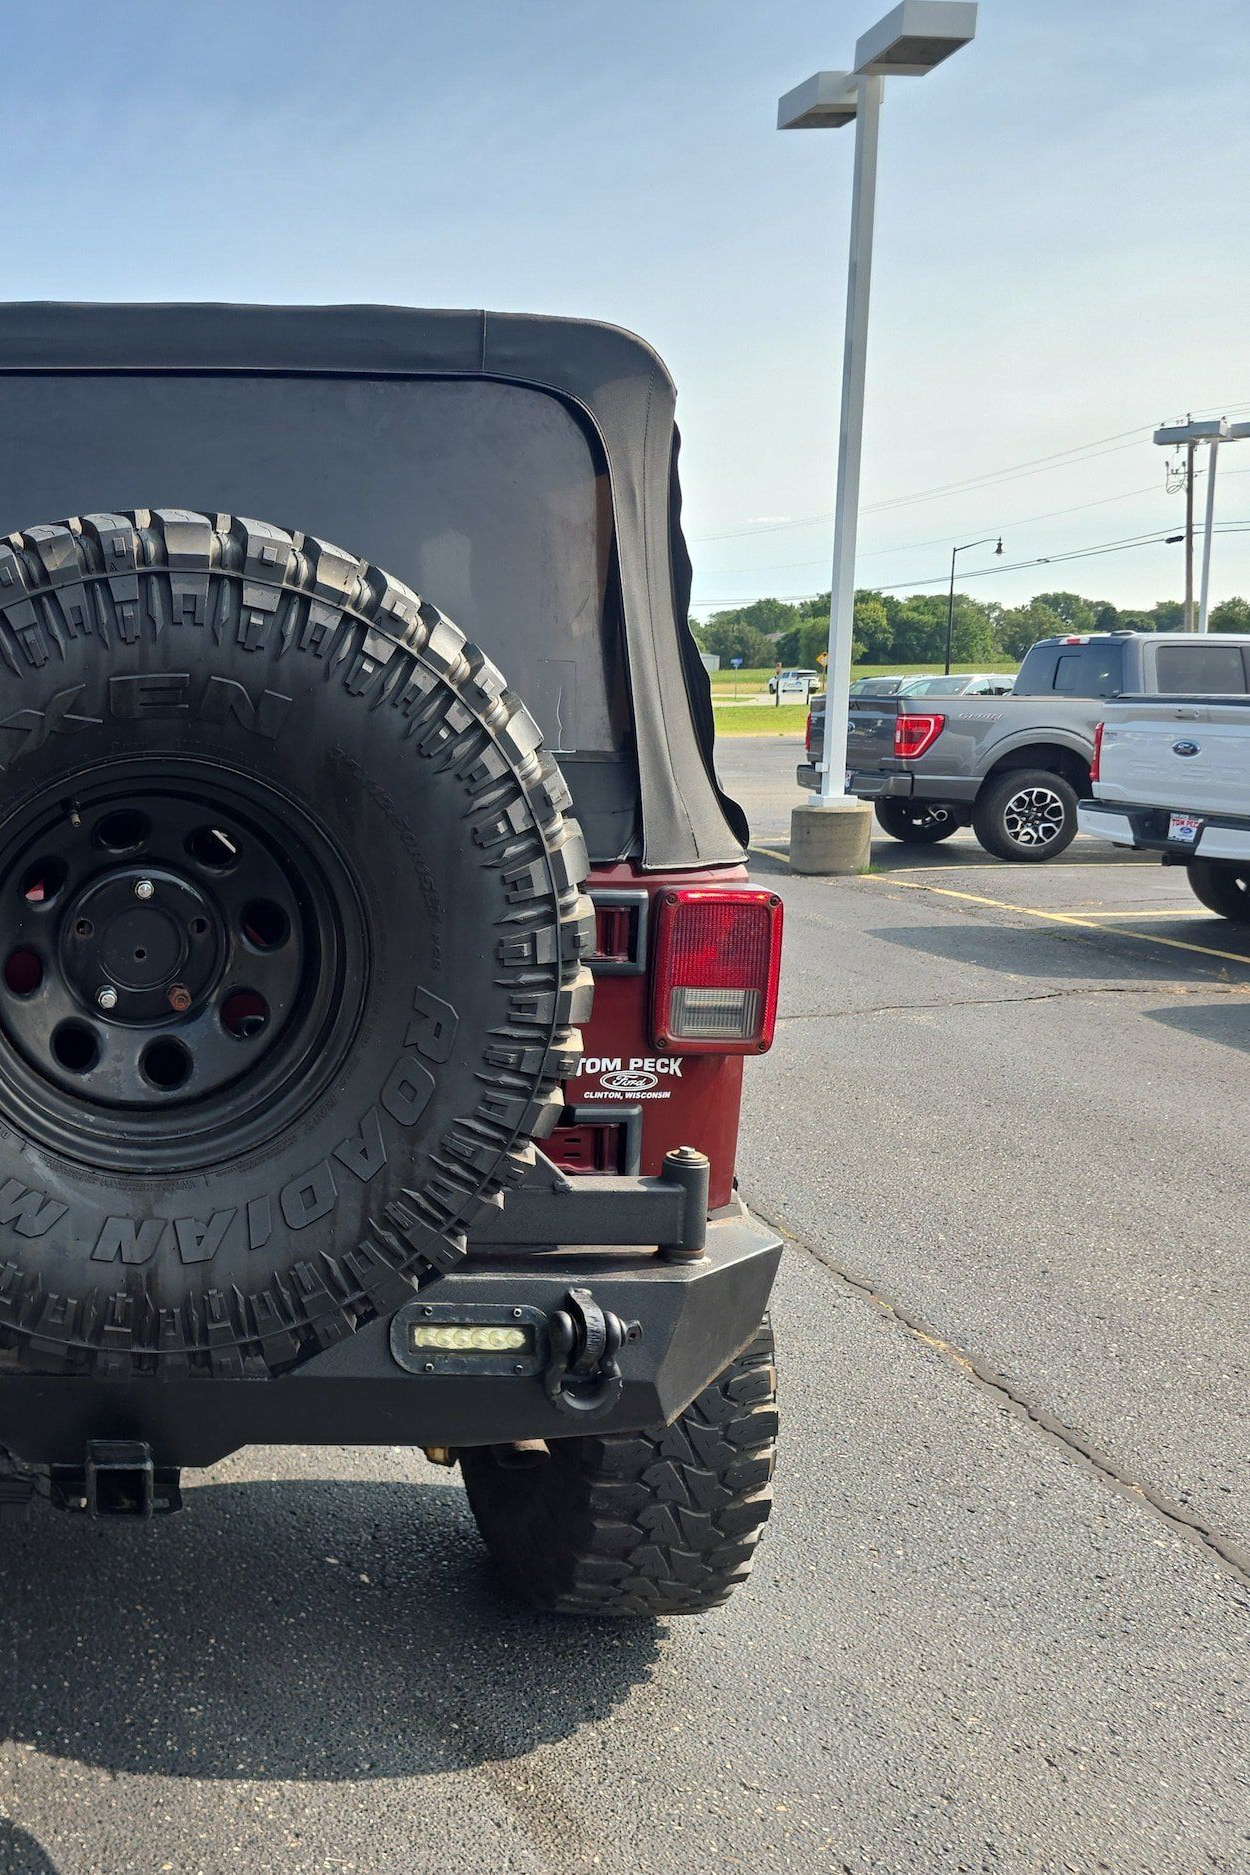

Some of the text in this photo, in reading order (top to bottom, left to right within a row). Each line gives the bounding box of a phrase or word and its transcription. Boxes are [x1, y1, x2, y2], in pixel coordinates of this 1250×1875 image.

[575, 1057, 684, 1078] TOM PECK
[611, 1074, 647, 1087] Ford
[583, 1090, 672, 1101] CLINTON, WISCONSIN
[90, 983, 461, 1265] ROADIAN
